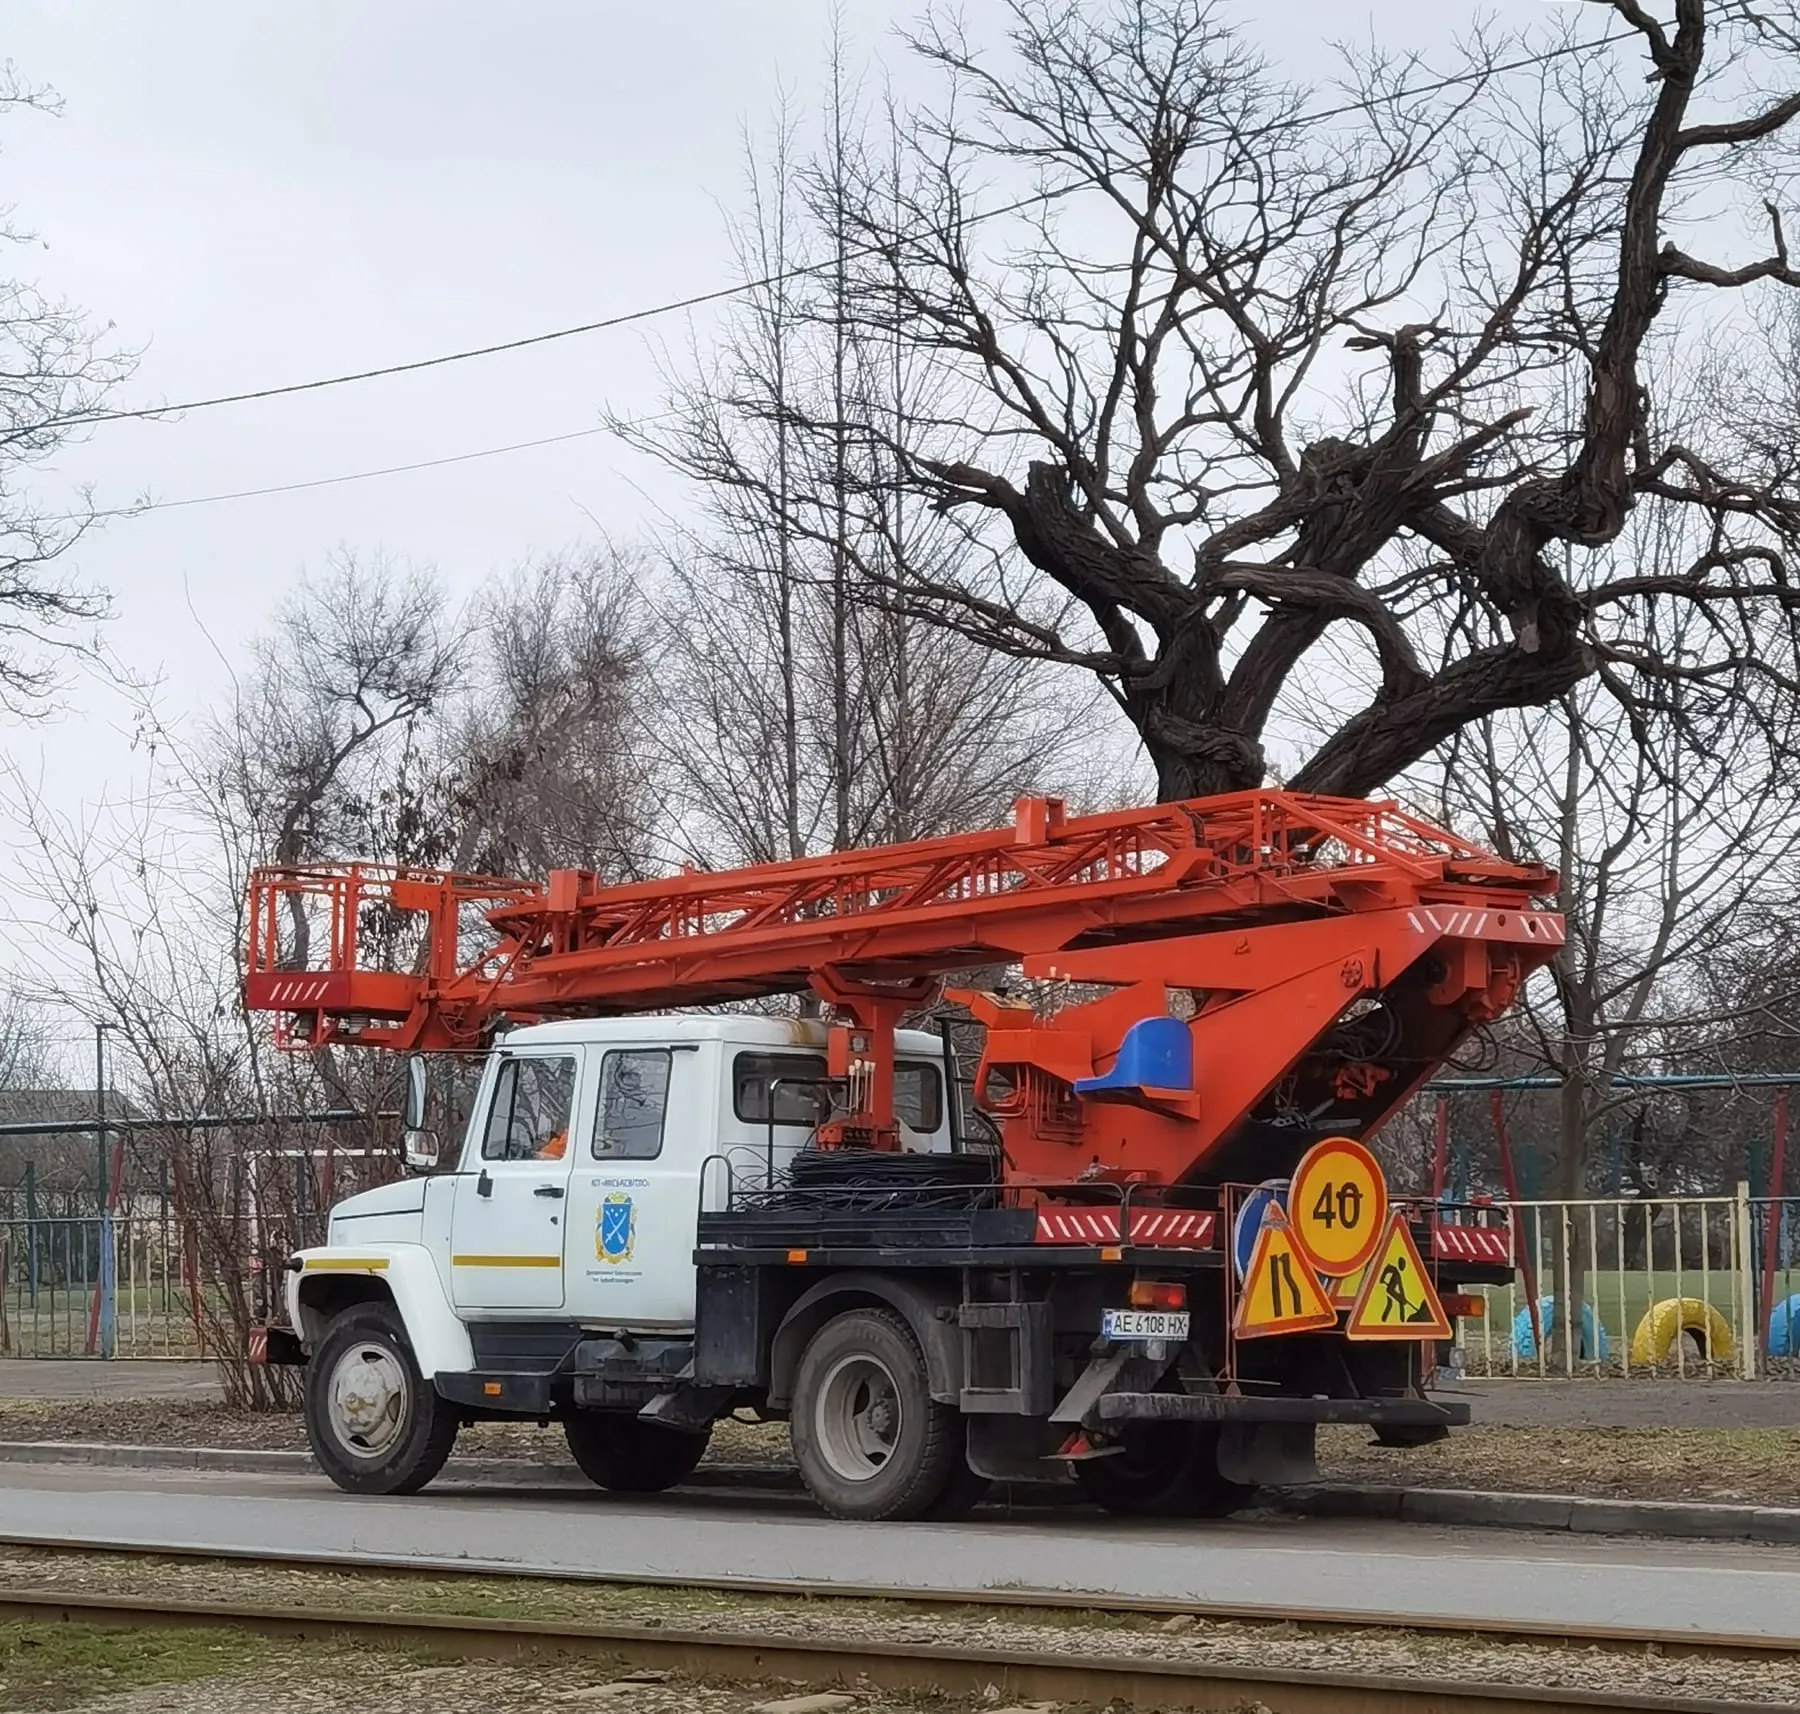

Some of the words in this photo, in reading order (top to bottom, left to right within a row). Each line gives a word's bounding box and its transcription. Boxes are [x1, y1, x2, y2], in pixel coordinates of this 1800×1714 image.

[1312, 1182, 1362, 1229] 40
[1113, 1314, 1133, 1333] AE
[1135, 1315, 1165, 1333] 6108
[1167, 1316, 1186, 1334] HX
